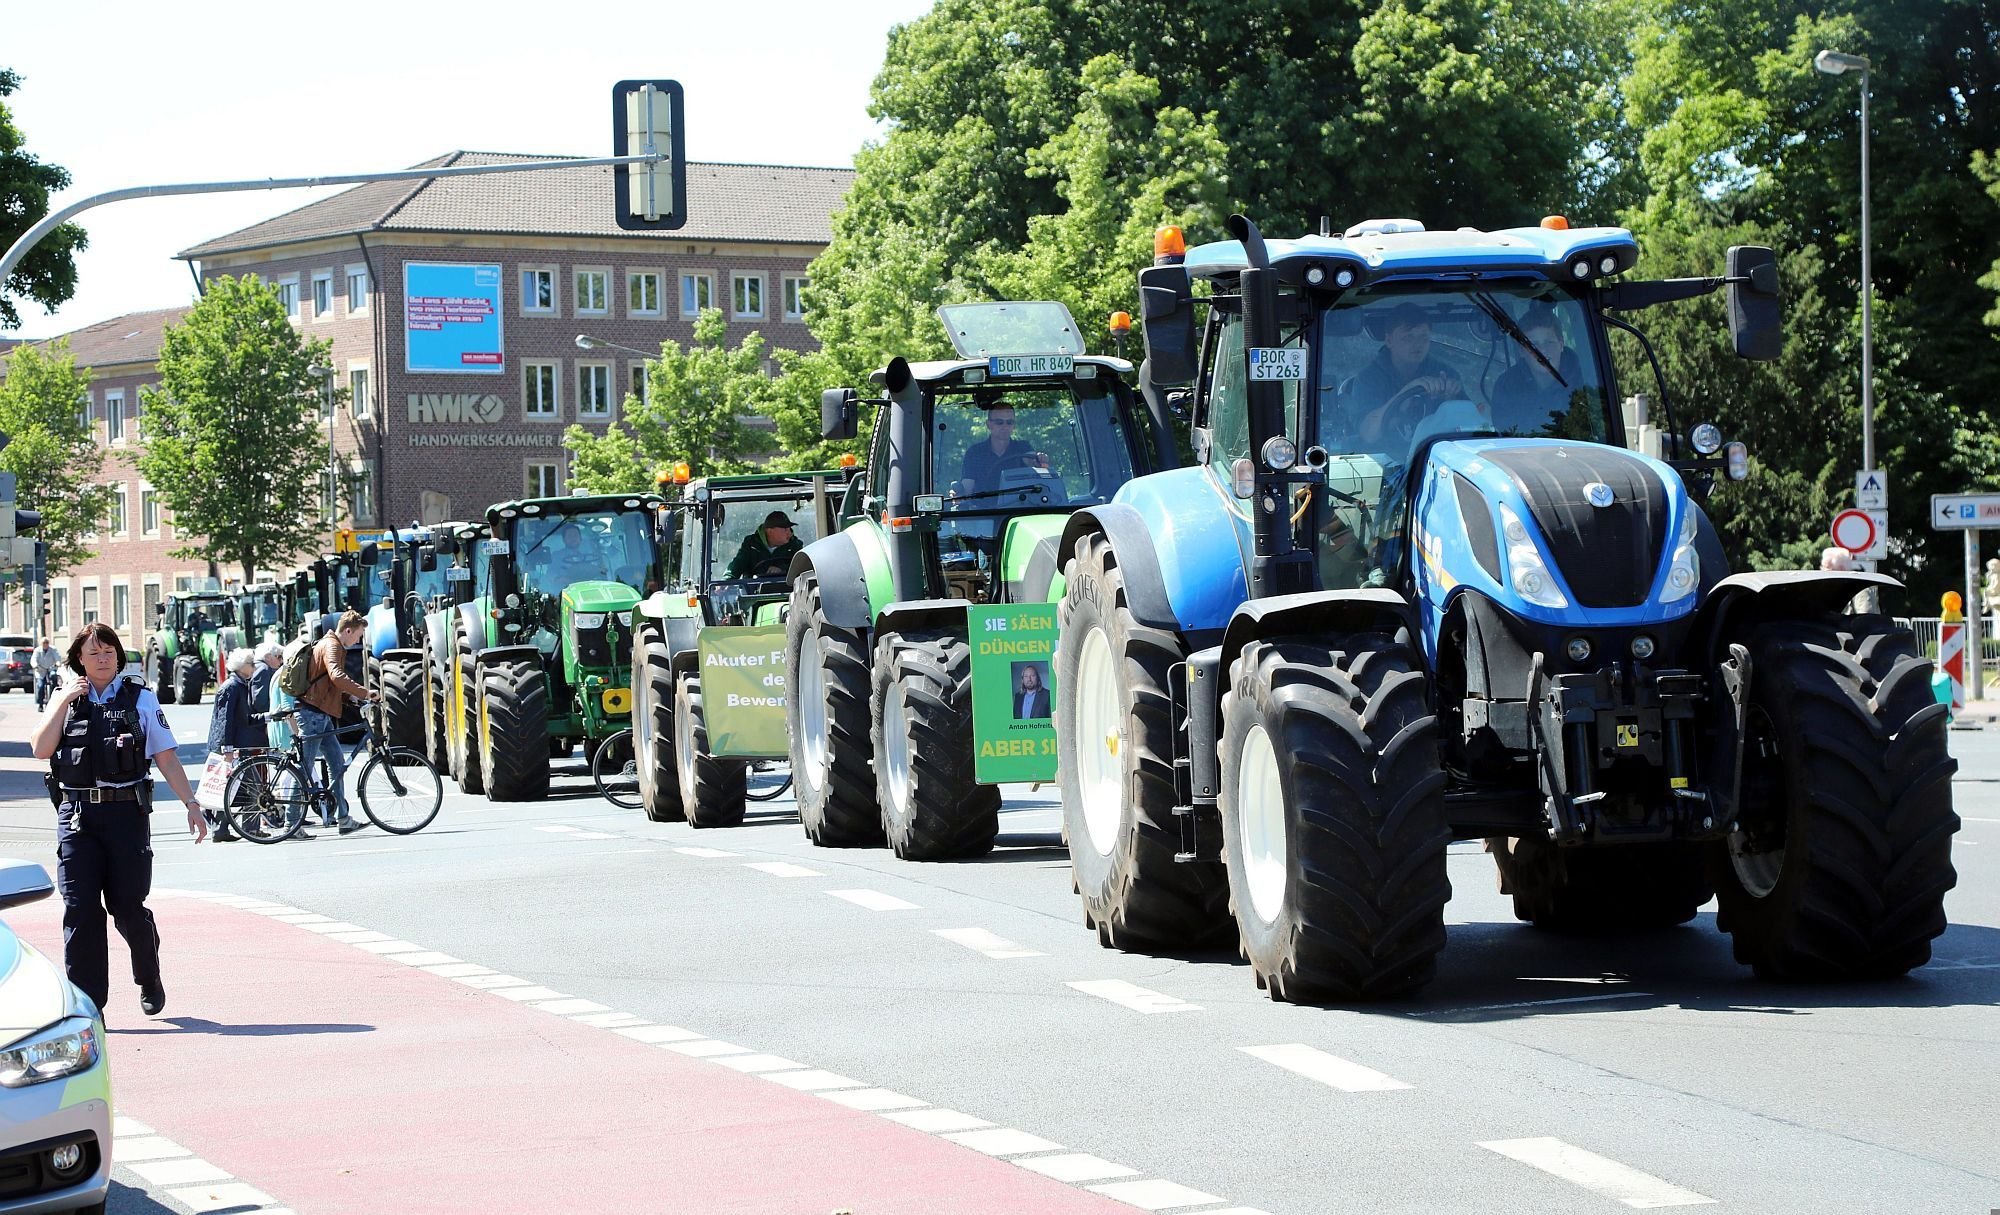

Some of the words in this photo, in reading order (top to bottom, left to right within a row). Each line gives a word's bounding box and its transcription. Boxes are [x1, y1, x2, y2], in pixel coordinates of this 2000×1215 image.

[998, 358, 1022, 372] BOR
[1030, 358, 1046, 372] HR
[1049, 356, 1072, 371] 849
[1260, 350, 1286, 363] BOR
[1256, 365, 1273, 378] ST
[1276, 364, 1300, 378] 263
[408, 394, 486, 423] HWK
[409, 434, 553, 447] HANDWERKSKAMMER
[985, 618, 1007, 631] SIE
[1011, 614, 1052, 631] SÄEN
[980, 638, 1050, 654] DÜNGEN
[706, 653, 766, 667] Akuter
[981, 739, 1036, 757] ABER
